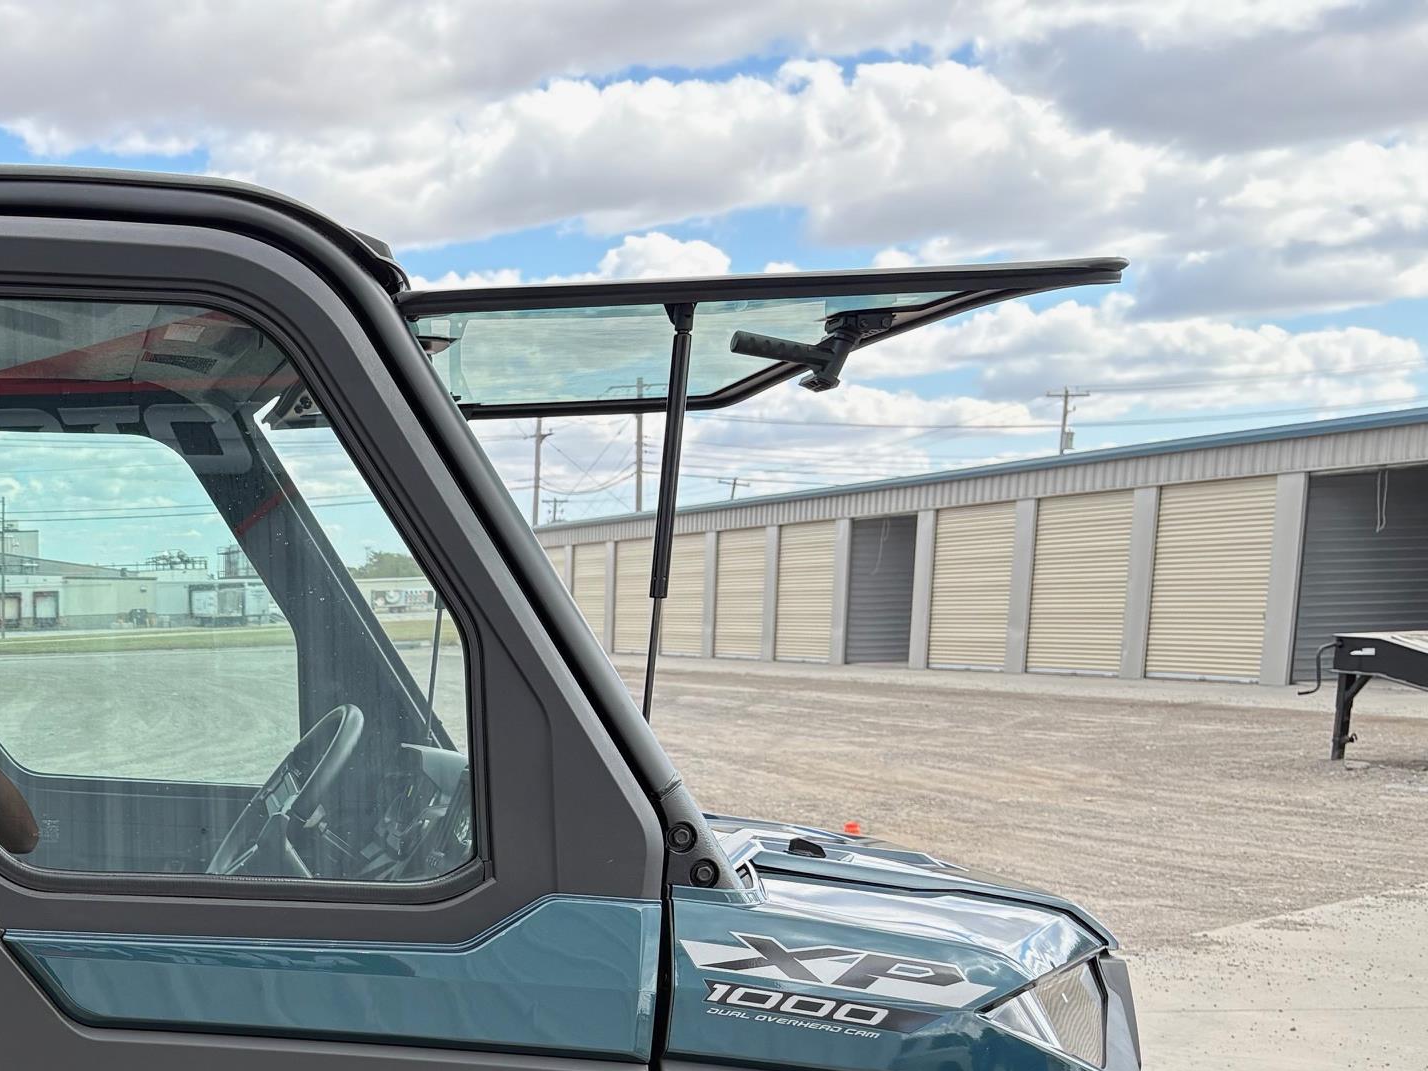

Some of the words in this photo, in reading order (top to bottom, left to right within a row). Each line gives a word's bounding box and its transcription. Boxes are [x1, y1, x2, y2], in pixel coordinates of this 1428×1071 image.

[699, 932, 968, 991] XP
[705, 983, 890, 1027] 1000
[706, 1007, 750, 1020] DUAL
[754, 1014, 842, 1034] OVERHEAD
[843, 1028, 881, 1040] CAM
